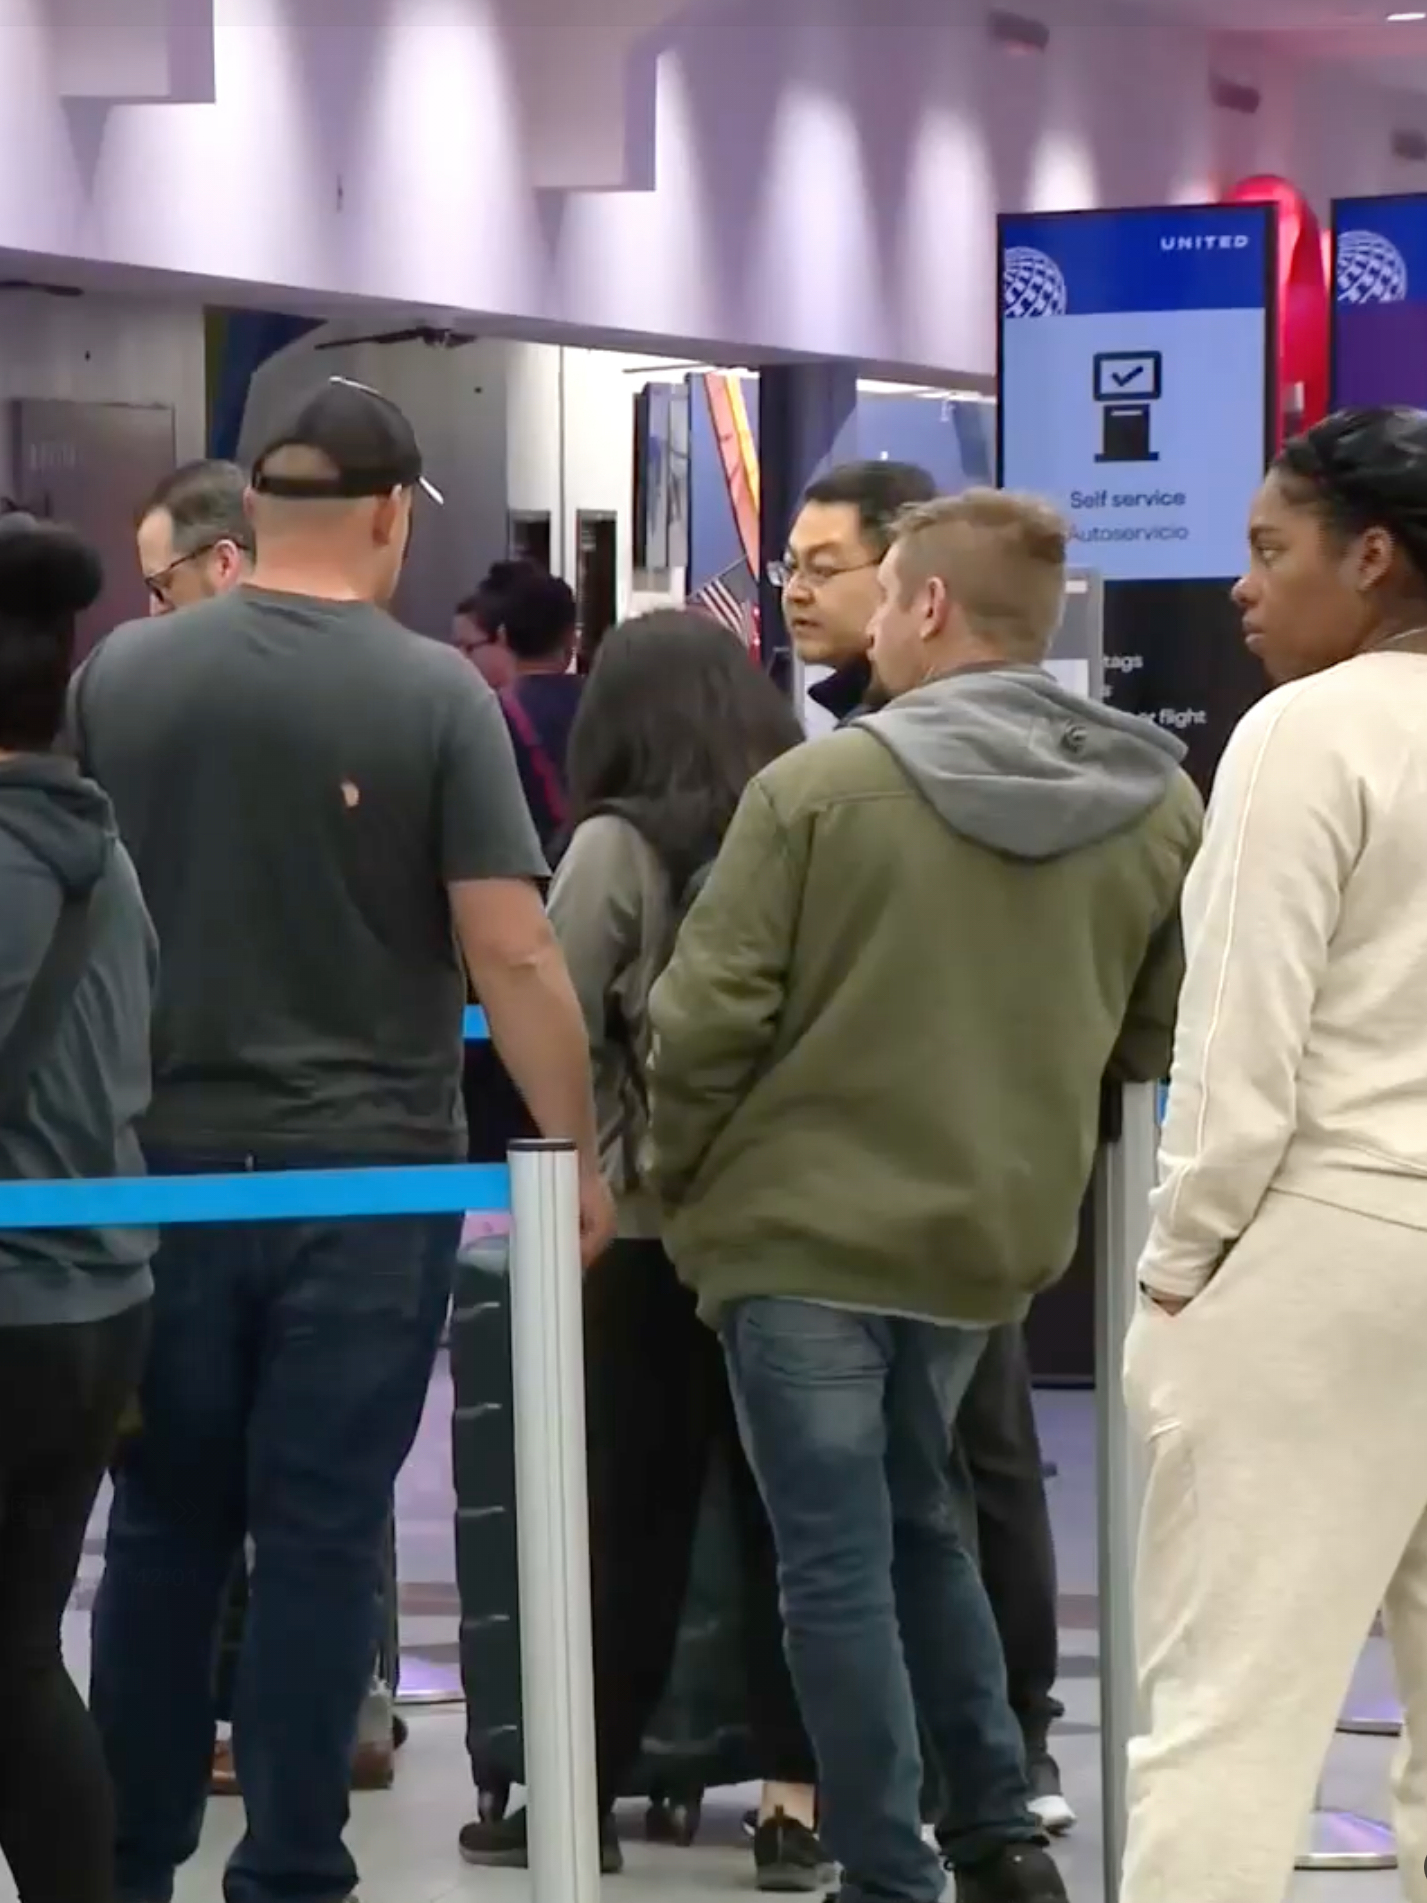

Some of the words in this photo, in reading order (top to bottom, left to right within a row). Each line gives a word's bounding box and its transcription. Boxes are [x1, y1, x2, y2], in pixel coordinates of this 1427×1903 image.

[1160, 235, 1249, 251] UNITED
[1070, 489, 1107, 509] Self
[1111, 489, 1186, 508] service
[1066, 524, 1189, 542] Autoservicio
[1159, 707, 1207, 728] flight
